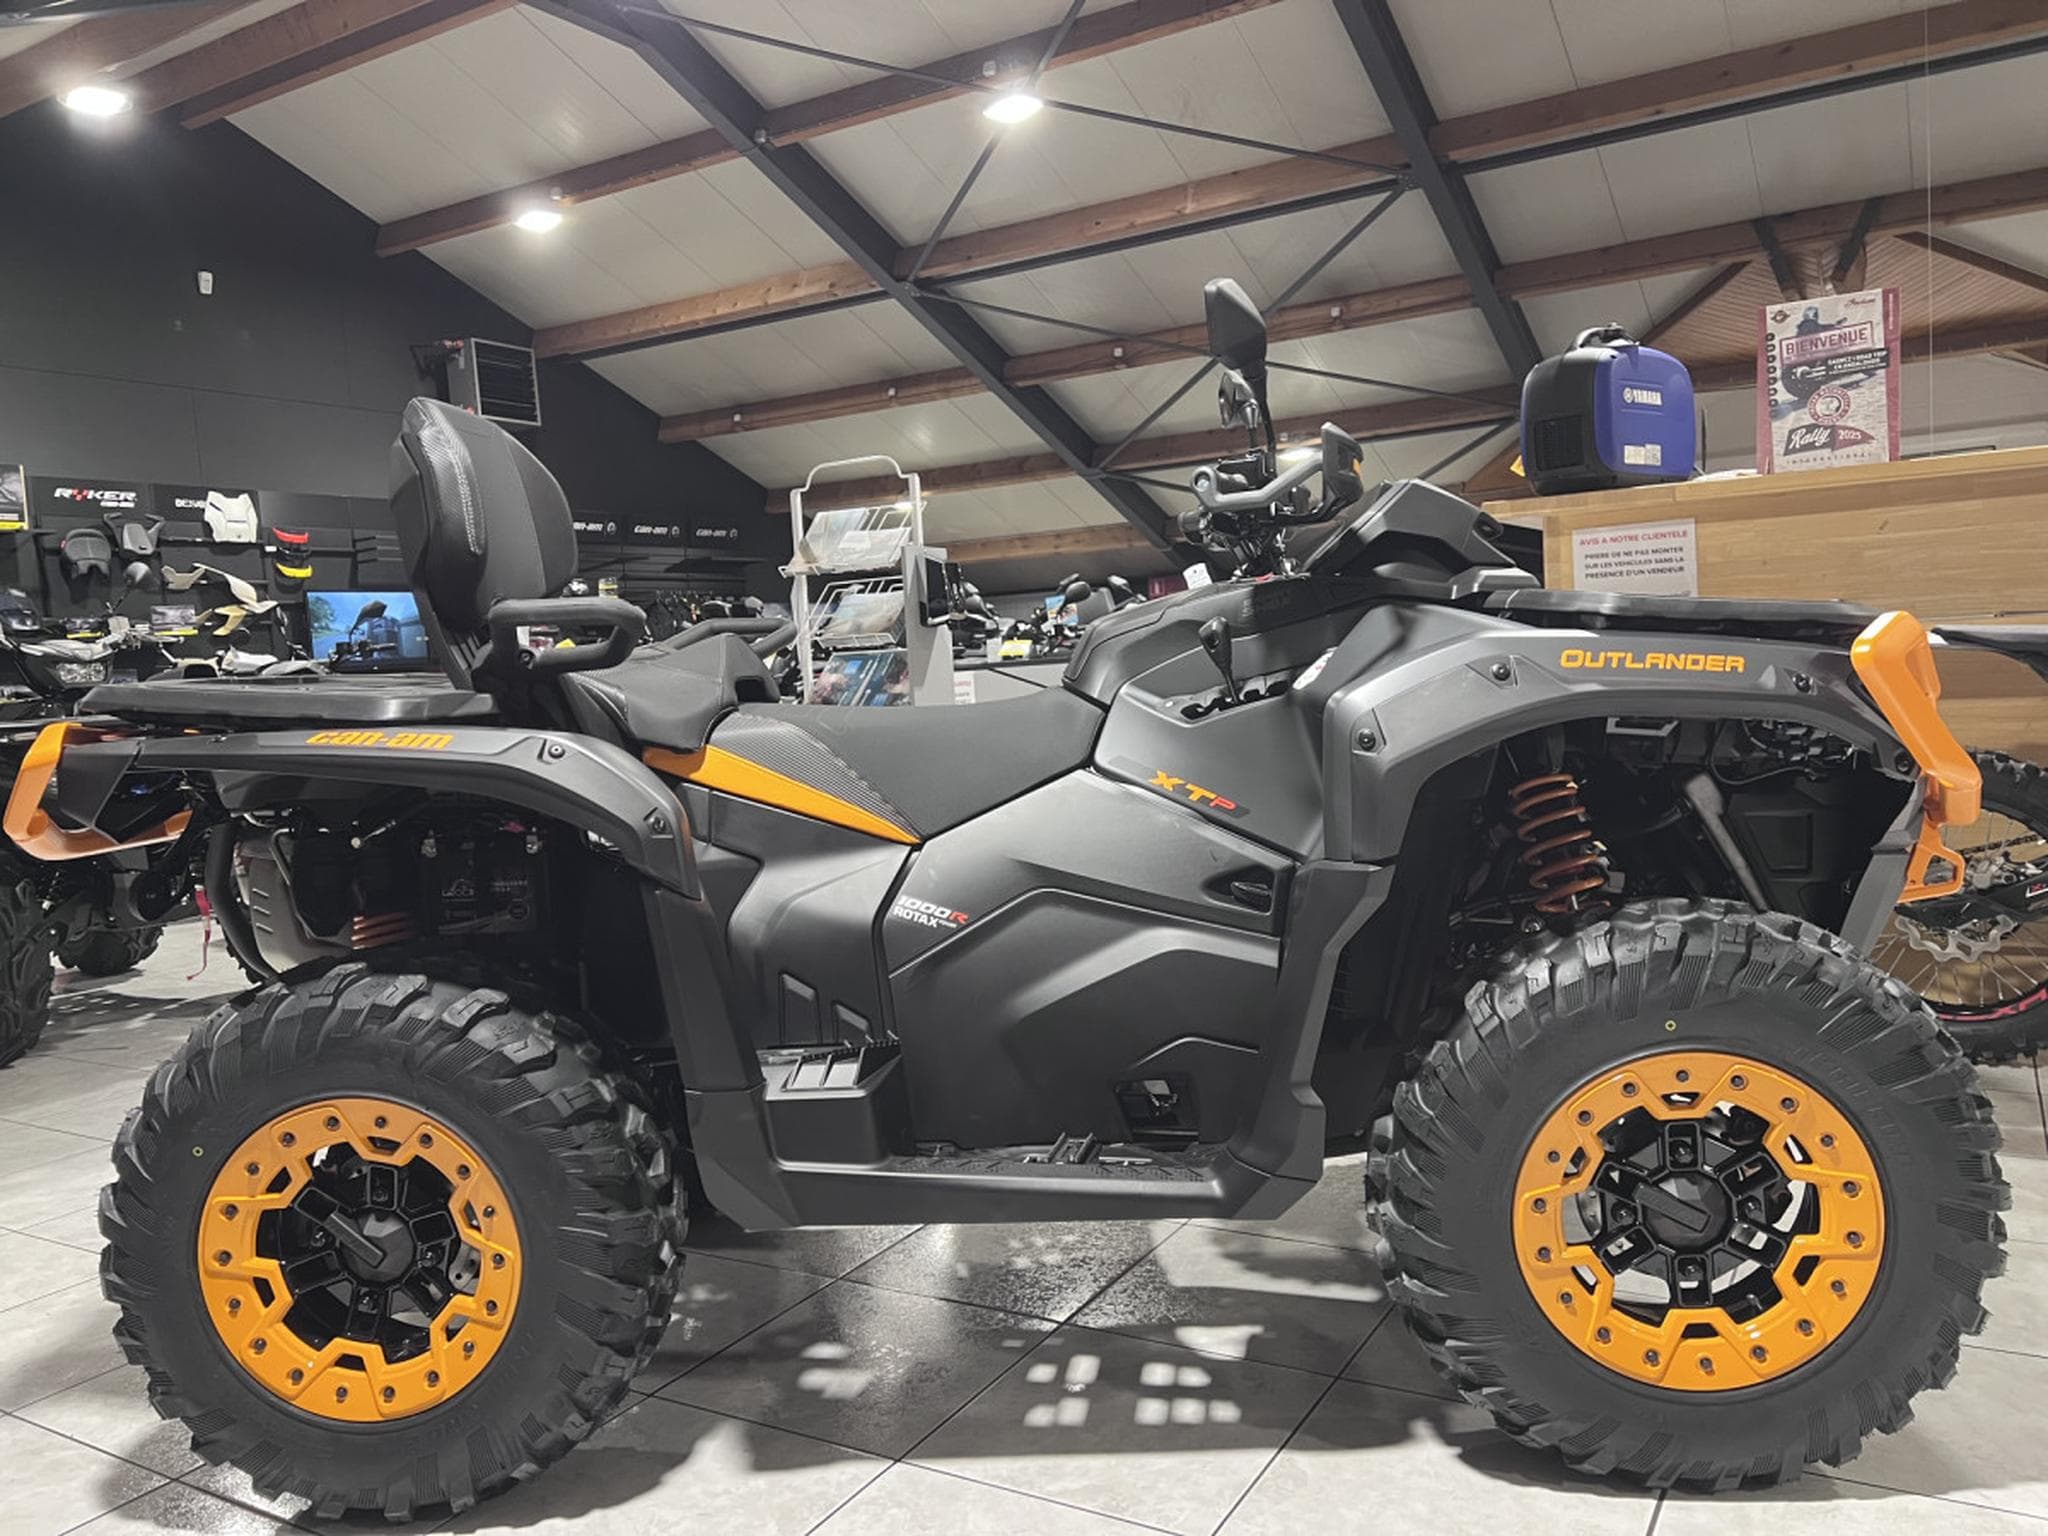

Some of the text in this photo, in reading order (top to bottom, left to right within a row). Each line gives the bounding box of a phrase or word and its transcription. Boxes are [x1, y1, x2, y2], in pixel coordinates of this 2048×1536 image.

[1785, 327, 1868, 356] BIENVENUE
[1632, 388, 1662, 406] YAMAHA
[1788, 426, 1831, 449] Rally
[1838, 428, 1862, 440] 2025
[53, 487, 137, 502] RYKER
[1579, 530, 1688, 546] AVIS A NOTRE CLIENTELE
[1585, 552, 1610, 560] PRIERE
[1611, 551, 1621, 559] DE
[1623, 550, 1633, 558] NE
[1651, 547, 1684, 555] MONTER
[1600, 561, 1613, 569] LES
[1614, 558, 1653, 568] VEHICULES
[1675, 555, 1685, 563] LA
[1585, 566, 1685, 579] PRESENCE D'UN VENDEUR
[1560, 648, 1745, 673] OUTLANDER
[893, 904, 938, 928] ROTAX
[897, 895, 969, 924] 1000R
